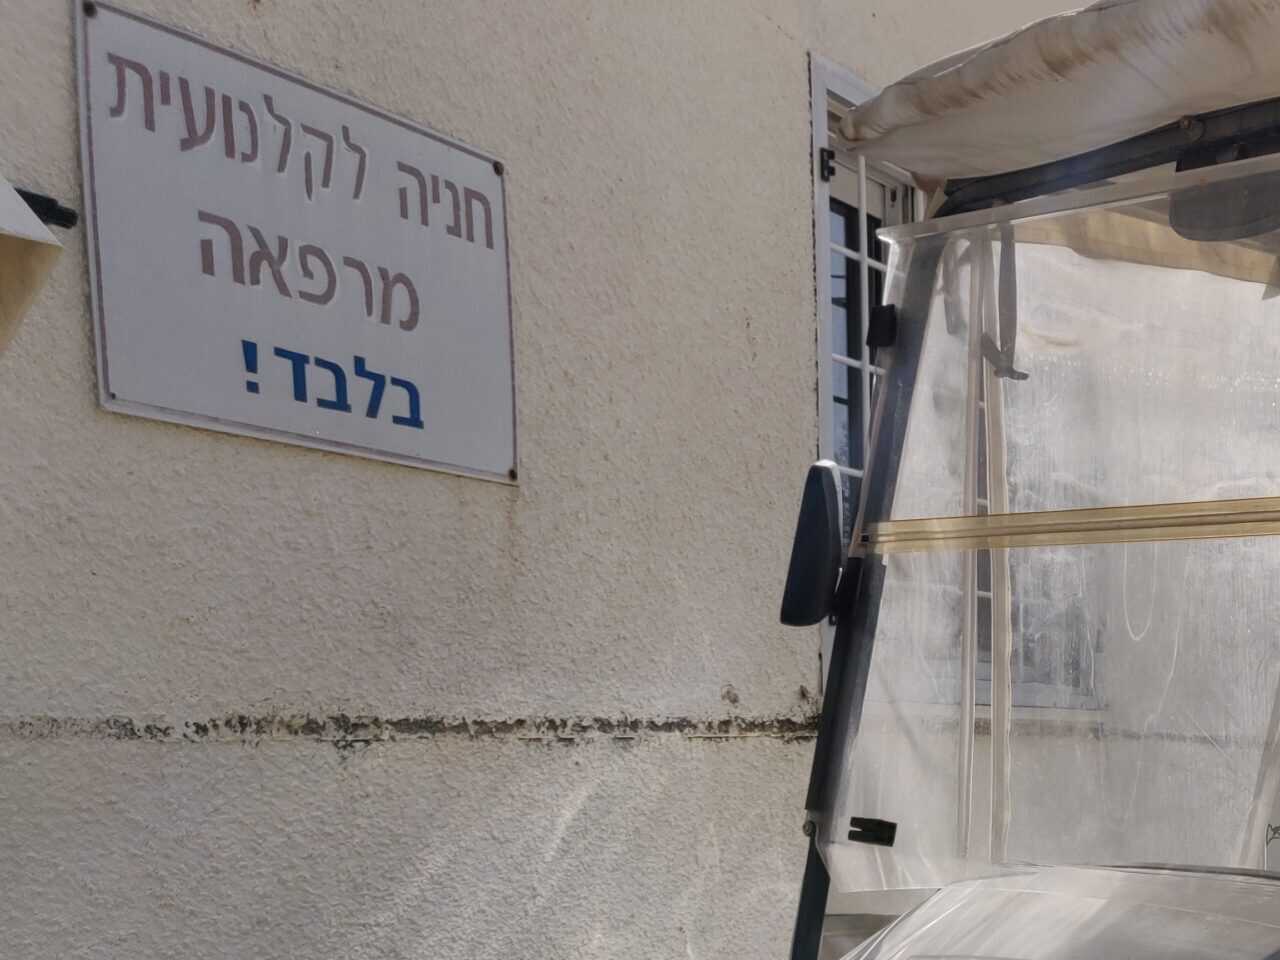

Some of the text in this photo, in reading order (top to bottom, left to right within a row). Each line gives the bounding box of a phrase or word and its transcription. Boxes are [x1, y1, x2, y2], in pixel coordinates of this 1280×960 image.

[106, 51, 495, 250] חניה לקלנועית
[198, 209, 420, 332] מרפאה
[240, 339, 425, 429] בלבד!
